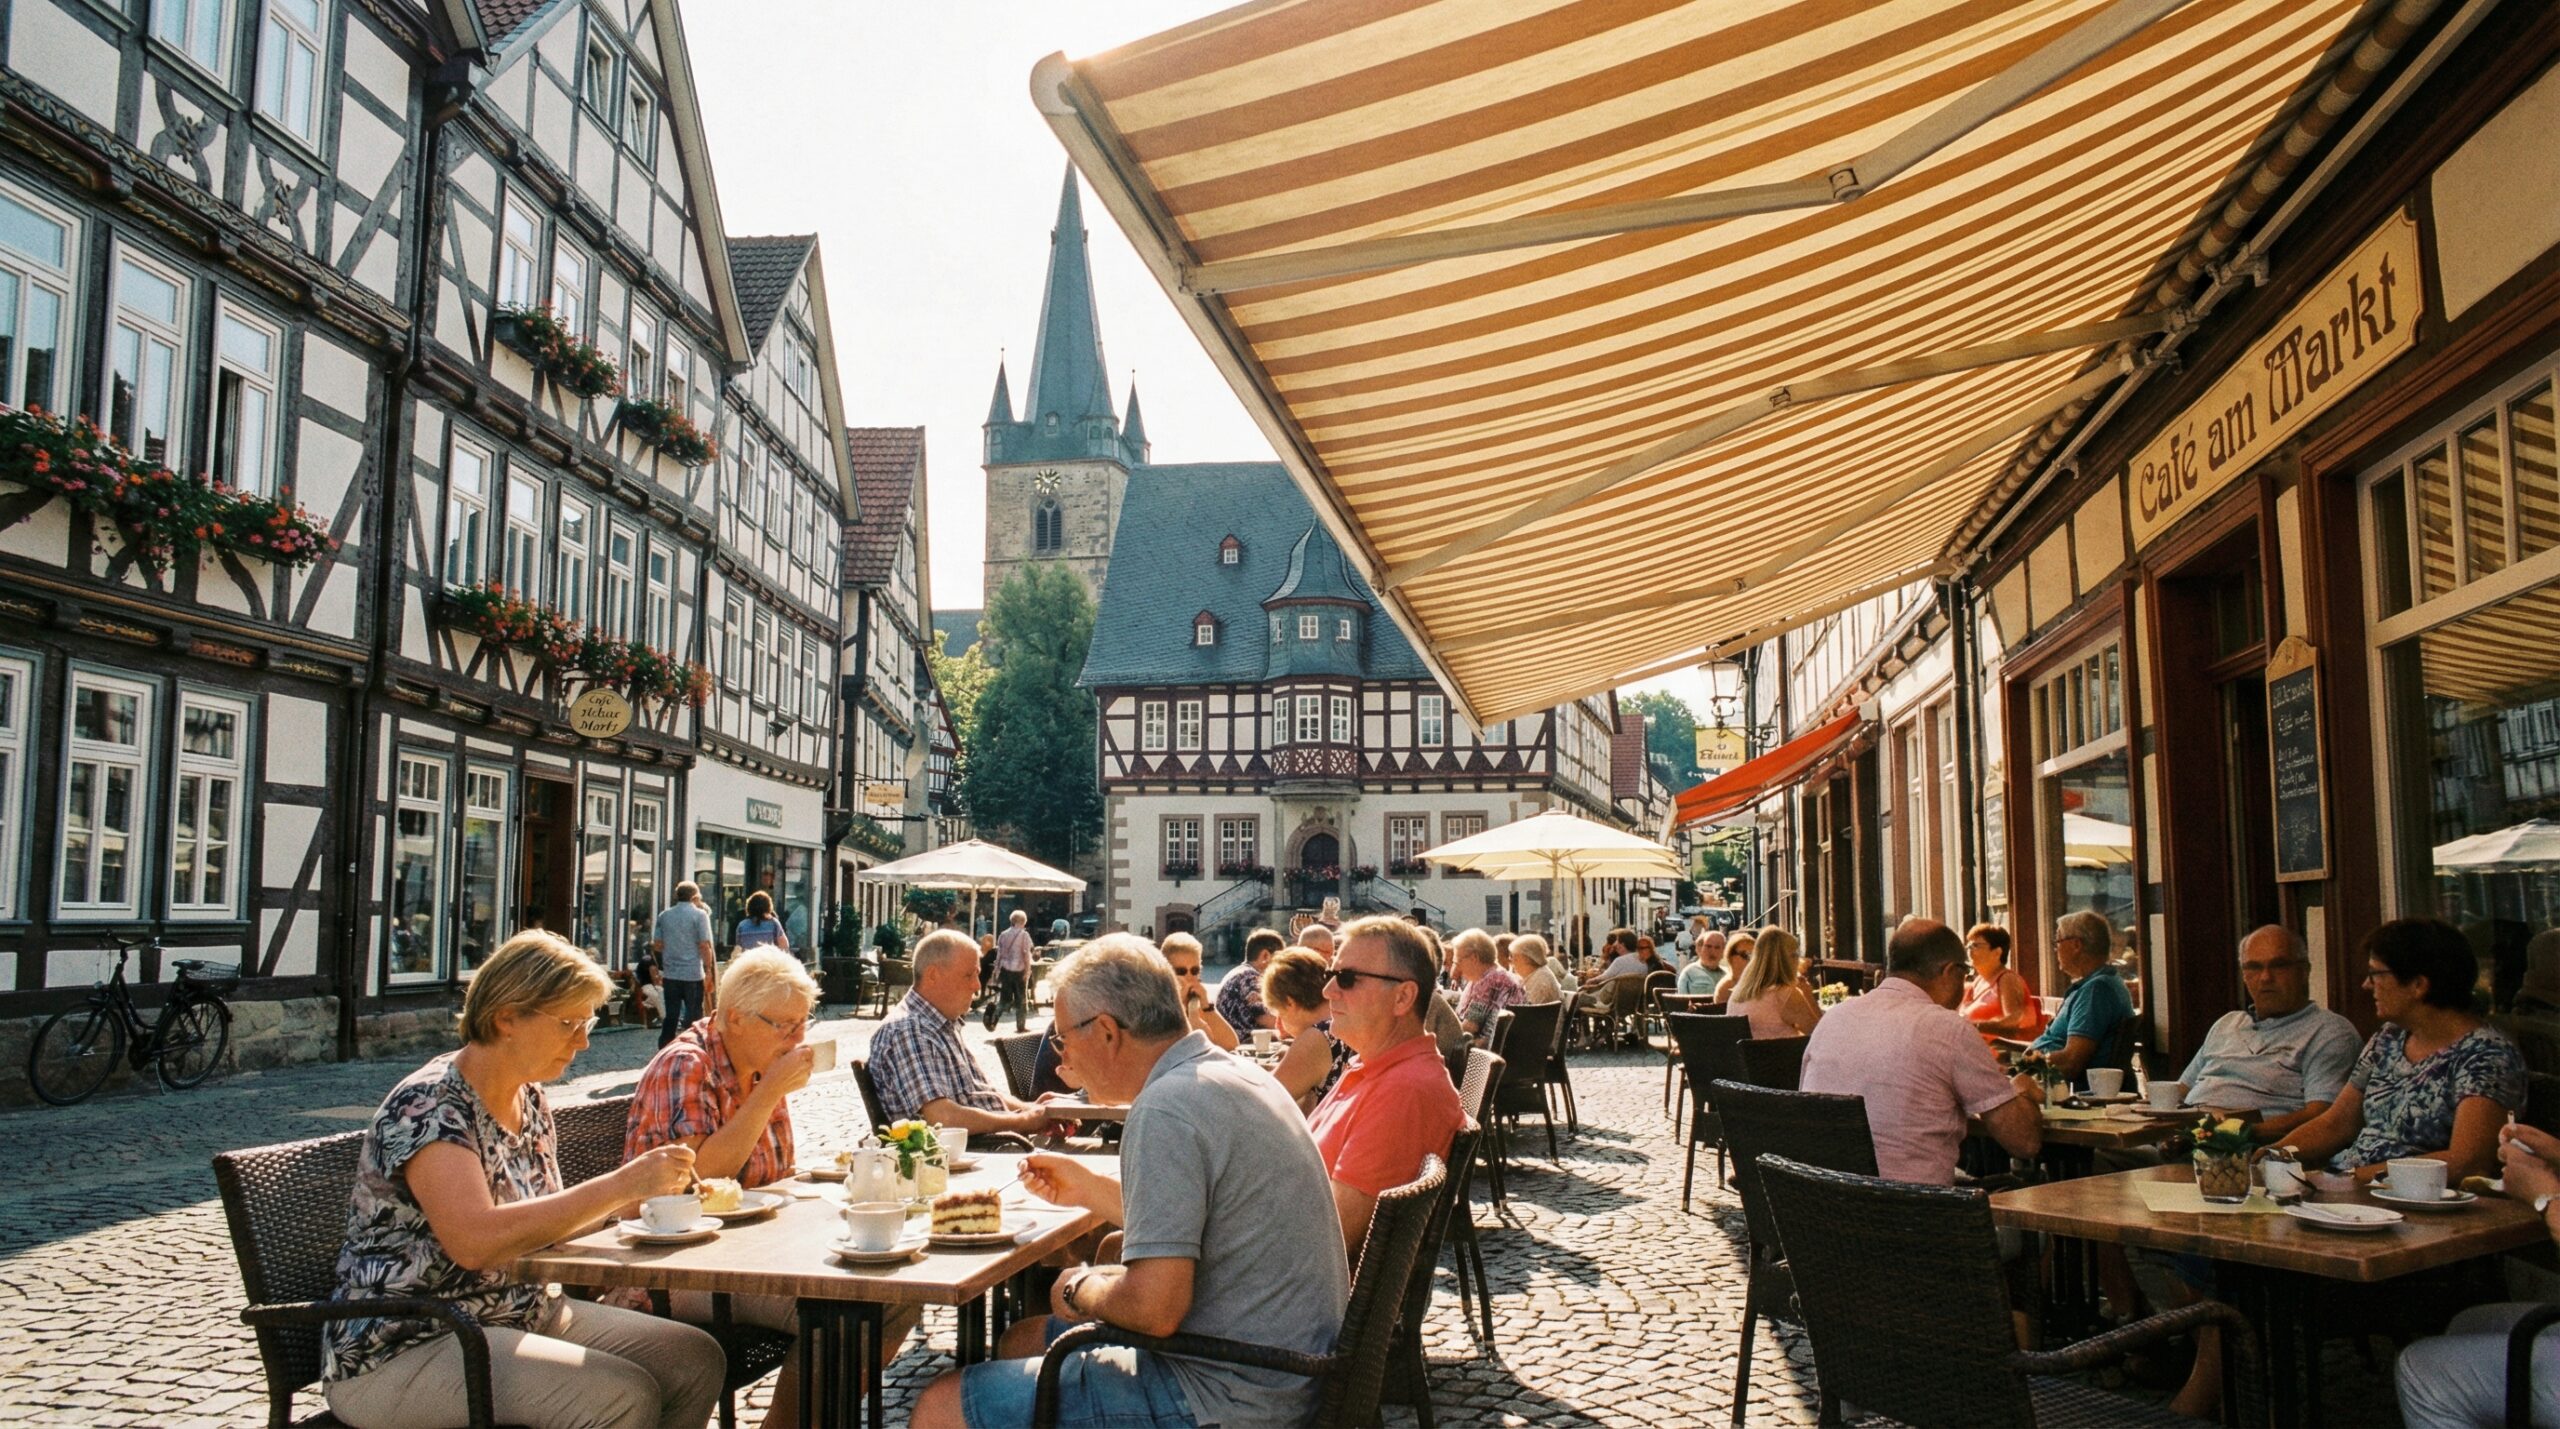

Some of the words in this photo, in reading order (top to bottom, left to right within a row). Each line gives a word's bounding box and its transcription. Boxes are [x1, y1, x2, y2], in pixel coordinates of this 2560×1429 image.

[2139, 421, 2198, 523] Café
[2207, 392, 2257, 473] am
[2263, 251, 2396, 426] Markt
